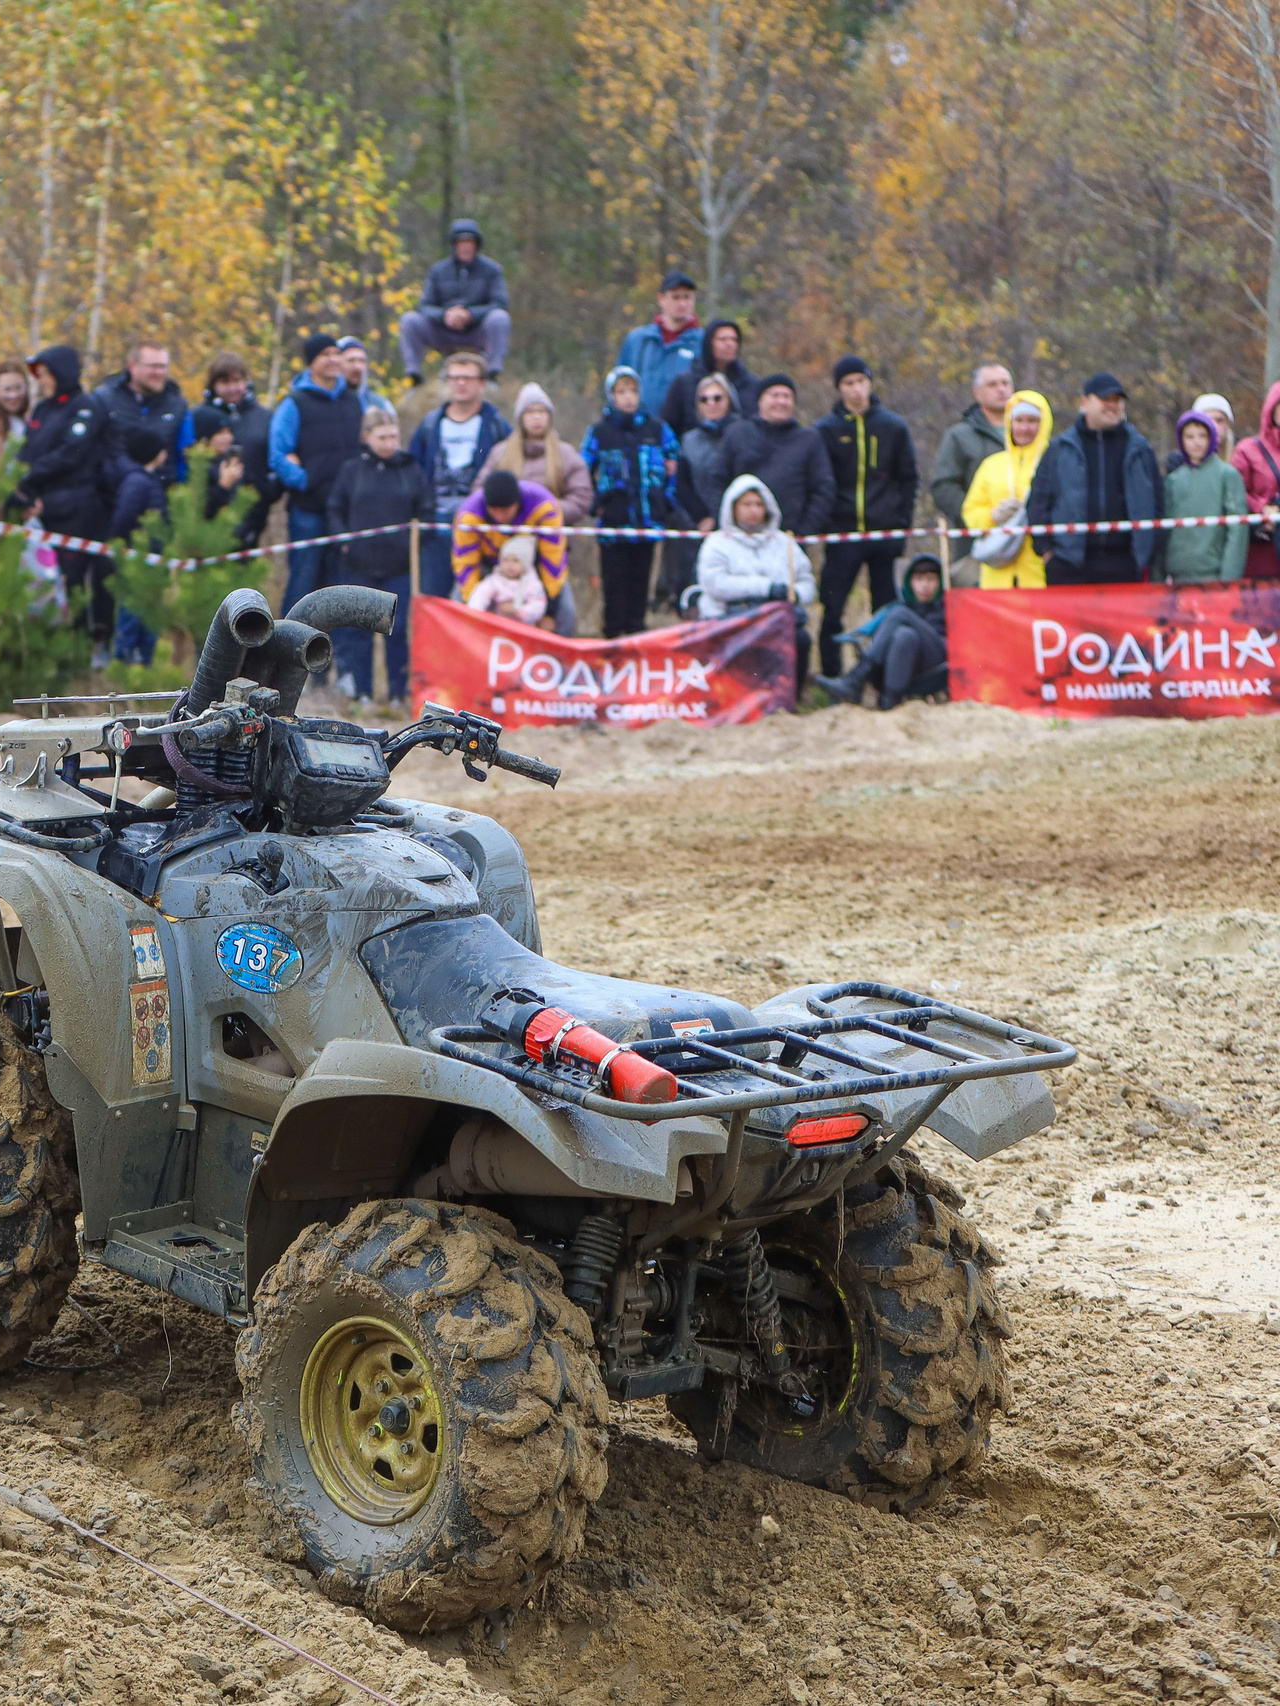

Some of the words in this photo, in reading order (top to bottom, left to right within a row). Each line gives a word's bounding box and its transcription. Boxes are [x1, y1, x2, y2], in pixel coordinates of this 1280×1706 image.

[1041, 683, 1057, 700] В
[1066, 681, 1153, 699] НАШИХ
[1160, 678, 1272, 698] СЕРДЦАХ
[491, 697, 506, 714] В
[514, 699, 597, 719] НАШИХ
[605, 701, 708, 721] СЕРДЦАХ
[232, 937, 290, 977] 137
